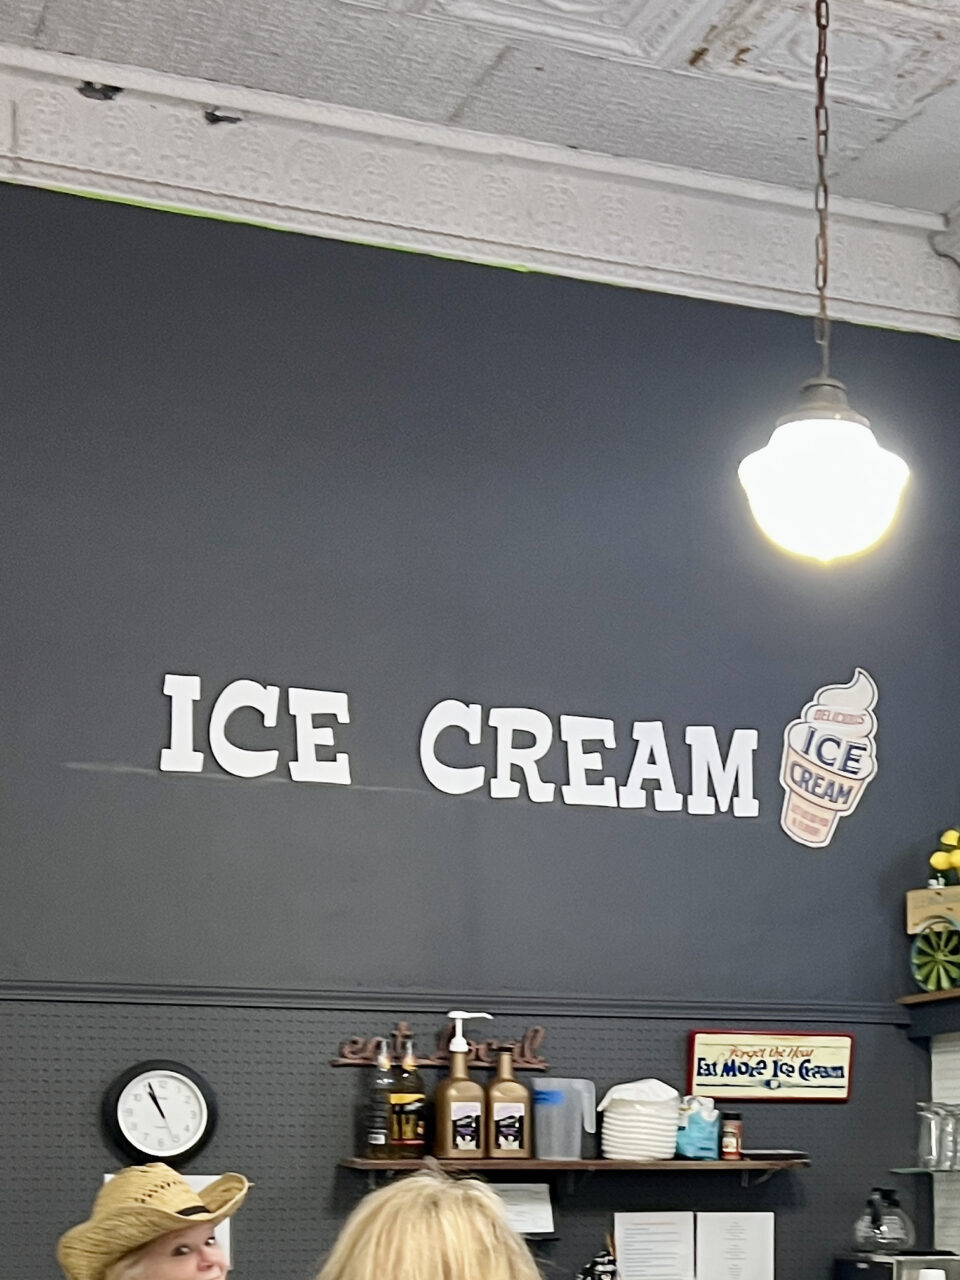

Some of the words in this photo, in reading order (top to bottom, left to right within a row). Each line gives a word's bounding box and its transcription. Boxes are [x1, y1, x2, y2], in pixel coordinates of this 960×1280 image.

[160, 673, 351, 786] ICE
[419, 698, 759, 818] CREAM
[801, 725, 868, 776] ICE
[790, 761, 854, 805] CREAM
[697, 1057, 717, 1077] Eat
[720, 1058, 767, 1078] More
[771, 1059, 796, 1079] Ice
